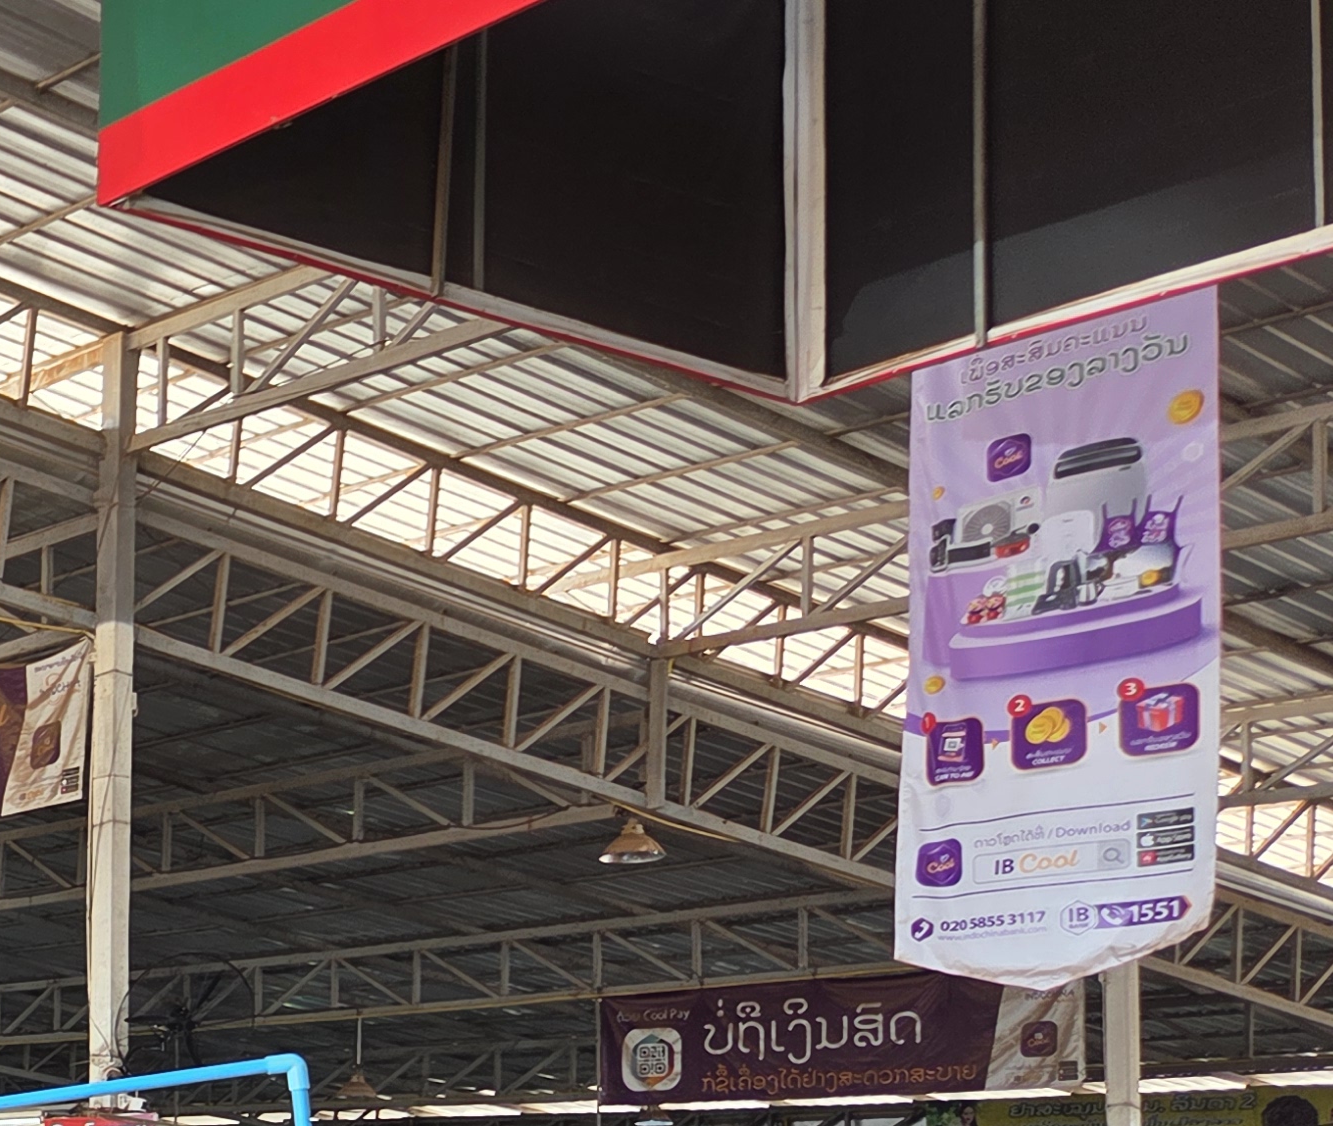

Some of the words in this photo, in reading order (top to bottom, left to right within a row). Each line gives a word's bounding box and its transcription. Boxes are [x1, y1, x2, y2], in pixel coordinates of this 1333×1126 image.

[1125, 683, 1138, 695] 3
[1014, 700, 1025, 712] 2
[1055, 818, 1131, 839] Download
[926, 858, 956, 874] Cool
[993, 858, 1014, 875] IB
[1018, 849, 1079, 874] Cool
[1007, 910, 1047, 925] 3117
[1068, 906, 1090, 922] IB
[1129, 900, 1181, 922] 1551
[643, 1009, 667, 1021] Cool
[669, 1008, 691, 1023] Pay
